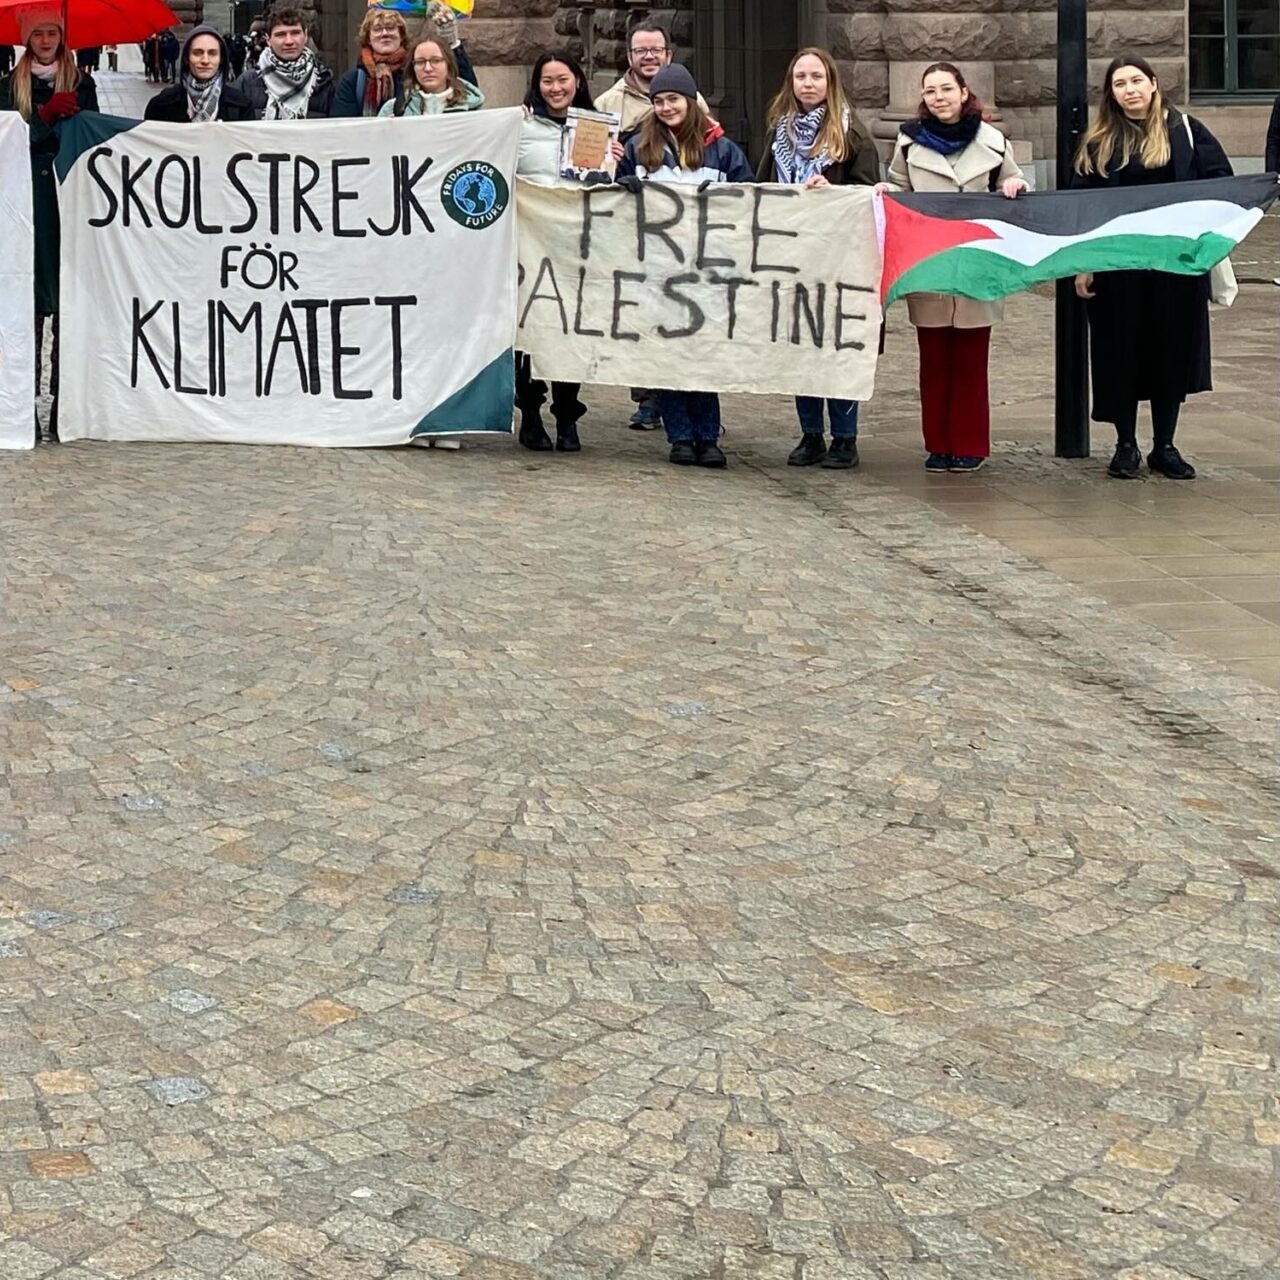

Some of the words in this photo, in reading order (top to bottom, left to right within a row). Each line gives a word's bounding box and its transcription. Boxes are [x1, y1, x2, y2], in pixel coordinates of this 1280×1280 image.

[87, 147, 435, 237] SKOLSTREJK
[443, 163, 473, 196] FRIDAYS
[475, 163, 495, 177] FOR
[465, 203, 503, 226] FUTURE
[220, 242, 299, 291] FÖR
[580, 180, 800, 274] FREE
[131, 295, 418, 400] KLIMATET
[518, 256, 876, 351] ALESTINE
